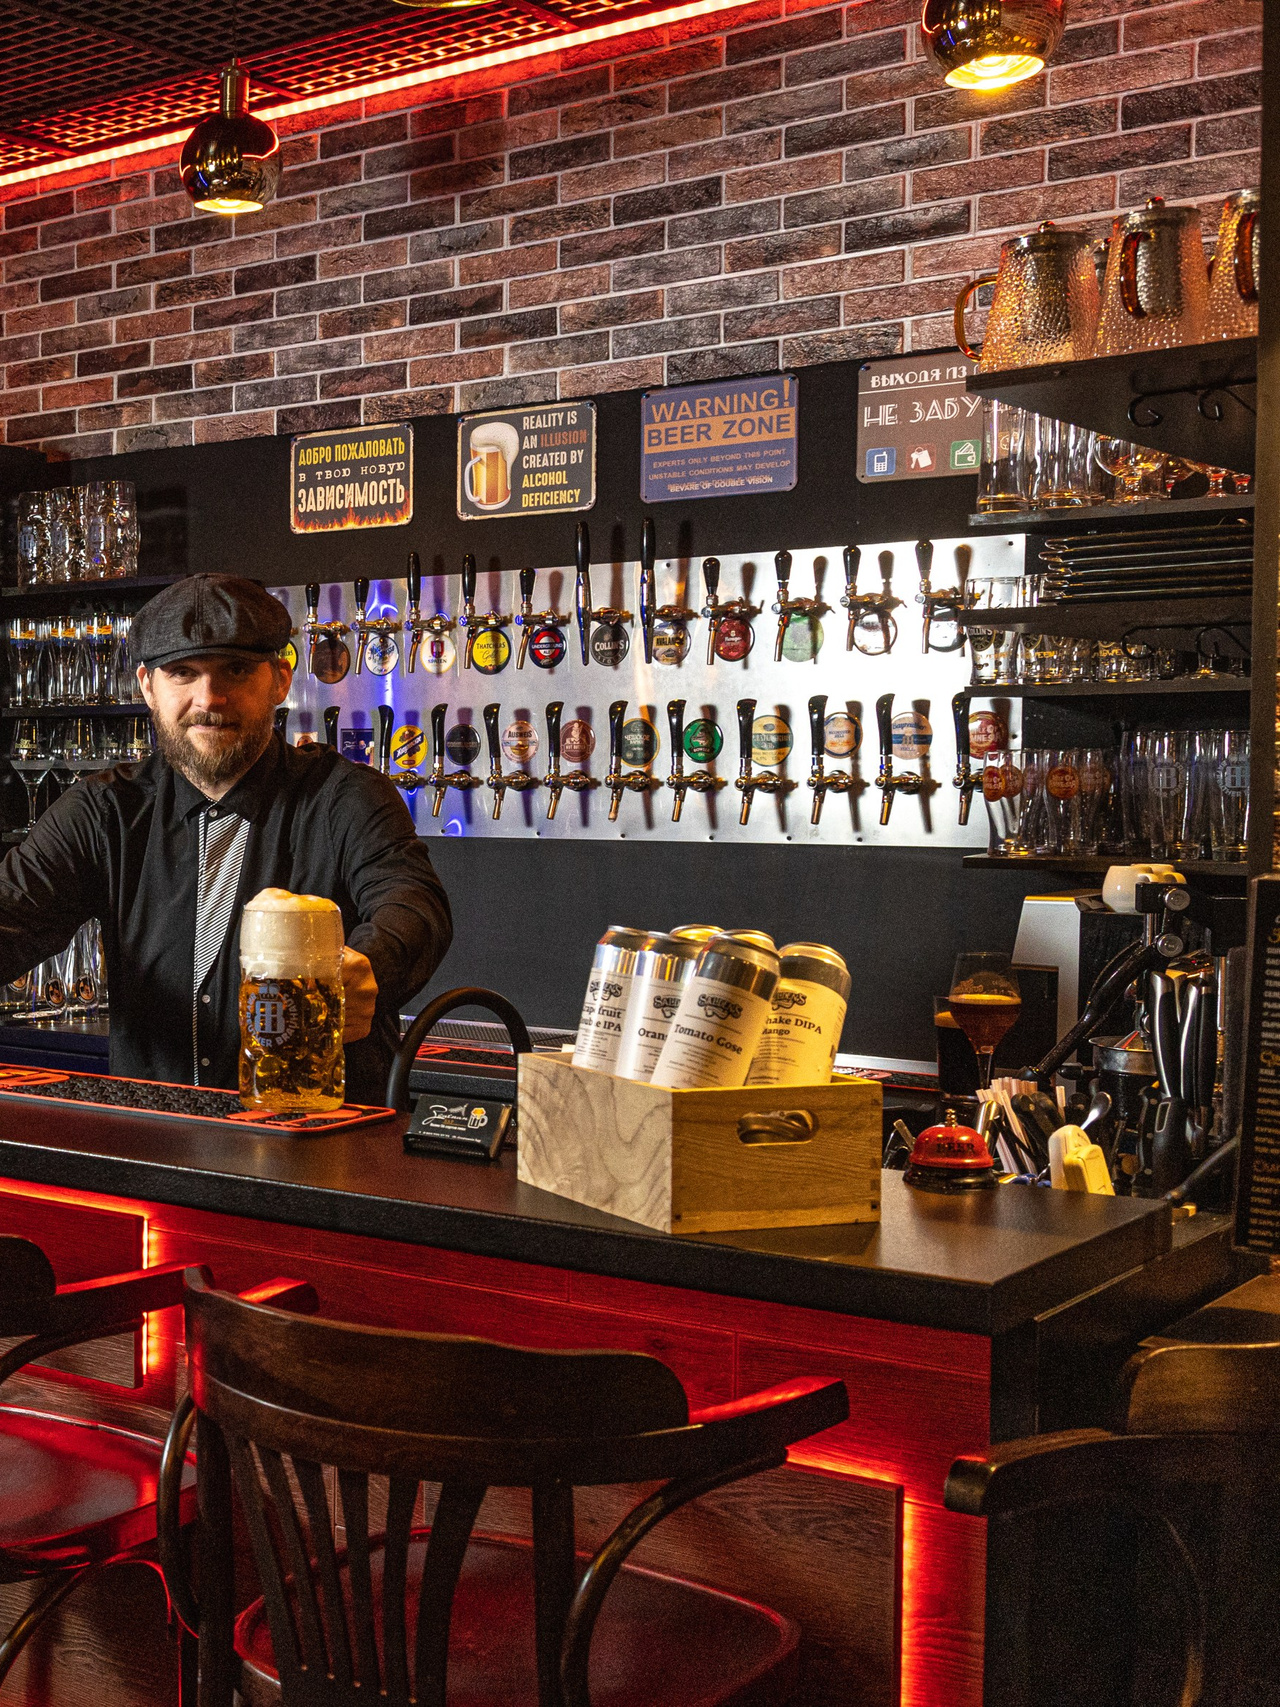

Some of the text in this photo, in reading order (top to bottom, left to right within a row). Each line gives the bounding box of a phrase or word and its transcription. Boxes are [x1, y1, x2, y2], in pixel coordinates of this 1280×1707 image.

[870, 367, 941, 388] ВЫХОДЯ
[651, 379, 790, 423] WARNING!
[522, 410, 577, 430] REALITY IS
[864, 403, 898, 427] НЕ
[522, 429, 587, 450] AN ILLUSION
[647, 413, 791, 448] BEER ZONE
[298, 437, 405, 466] ДОБРО ПОЖАЛОВАТЬ
[522, 449, 584, 469] CREATED BY
[652, 456, 685, 469] EXPERTS
[688, 456, 708, 465] ONLY
[710, 453, 742, 463] BEYOND
[744, 451, 760, 459] THIS
[522, 470, 568, 488] ALCOHOL
[648, 460, 791, 481] UNSTABLE CONDITIONS MAY DEVELOP
[747, 476, 773, 486] VISION
[298, 478, 405, 513] ЗАВИСИМОСТЬ
[522, 489, 581, 508] DEFICIENCY
[603, 1021, 622, 1032] IPA
[794, 1018, 822, 1035] DIPA
[674, 1024, 743, 1054] Tomato Gose
